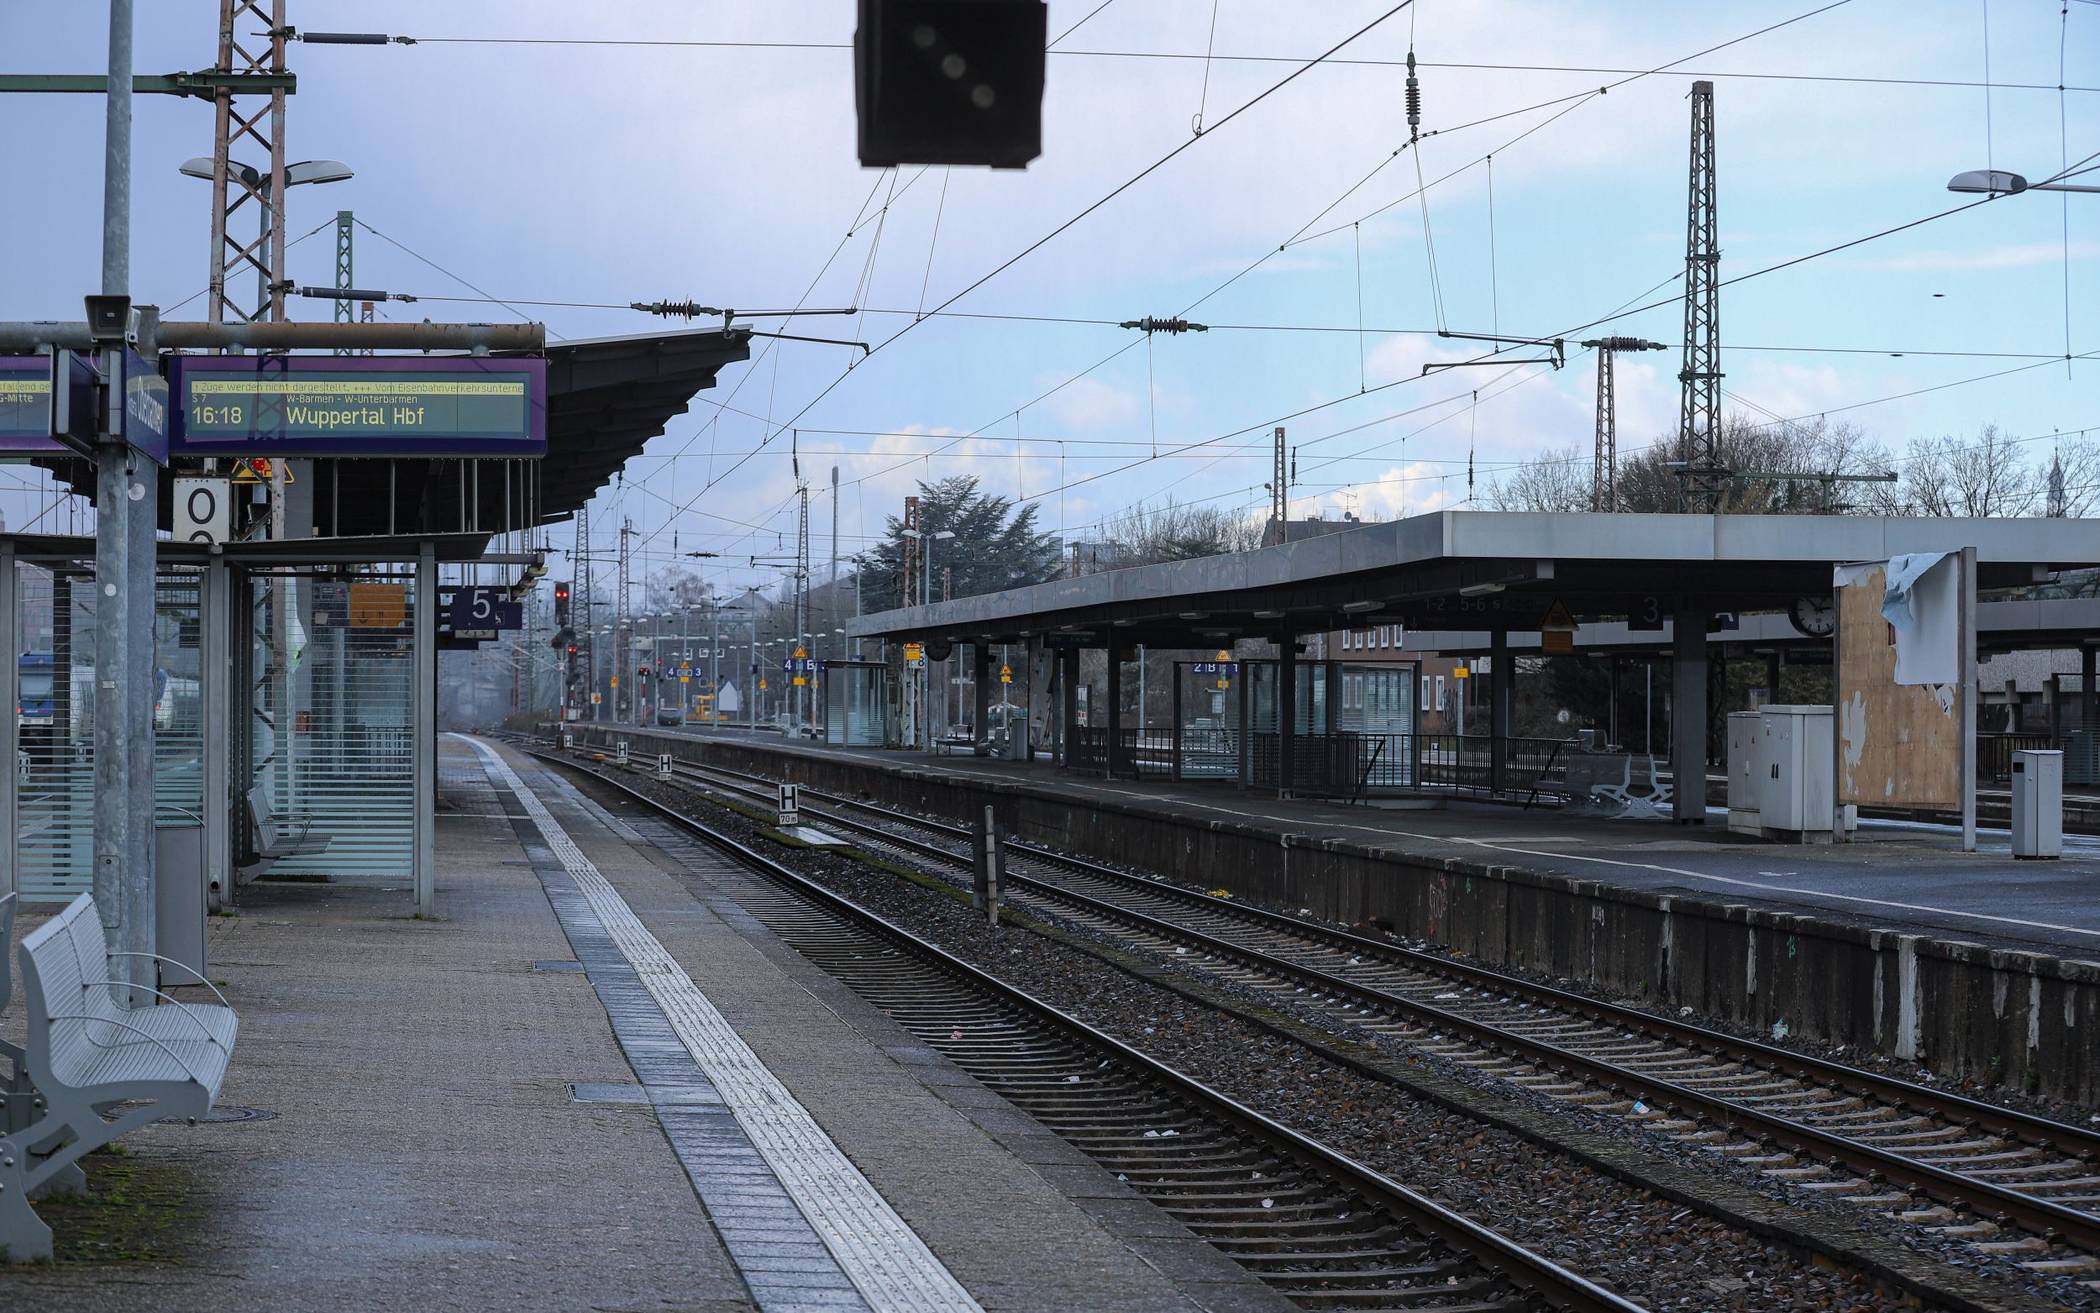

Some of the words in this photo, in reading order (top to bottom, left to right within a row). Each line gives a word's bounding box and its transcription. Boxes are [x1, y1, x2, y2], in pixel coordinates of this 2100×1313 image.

[226, 382, 263, 392] werden
[265, 382, 289, 392] nicht
[201, 394, 207, 403] 7
[286, 394, 334, 404] W-Barmen
[344, 394, 418, 404] W-Unterbarmen
[192, 406, 242, 425] 16:18
[286, 406, 385, 429] Wuppertal
[393, 407, 425, 425] Hbf
[188, 488, 215, 525] 0
[471, 589, 491, 619] 5
[1643, 596, 1658, 623] 3
[784, 659, 792, 670] 4
[1194, 663, 1202, 673] 2
[1208, 663, 1216, 673] B
[695, 667, 702, 677] 3
[618, 743, 627, 756] H
[660, 756, 671, 771] H
[781, 786, 796, 810] H
